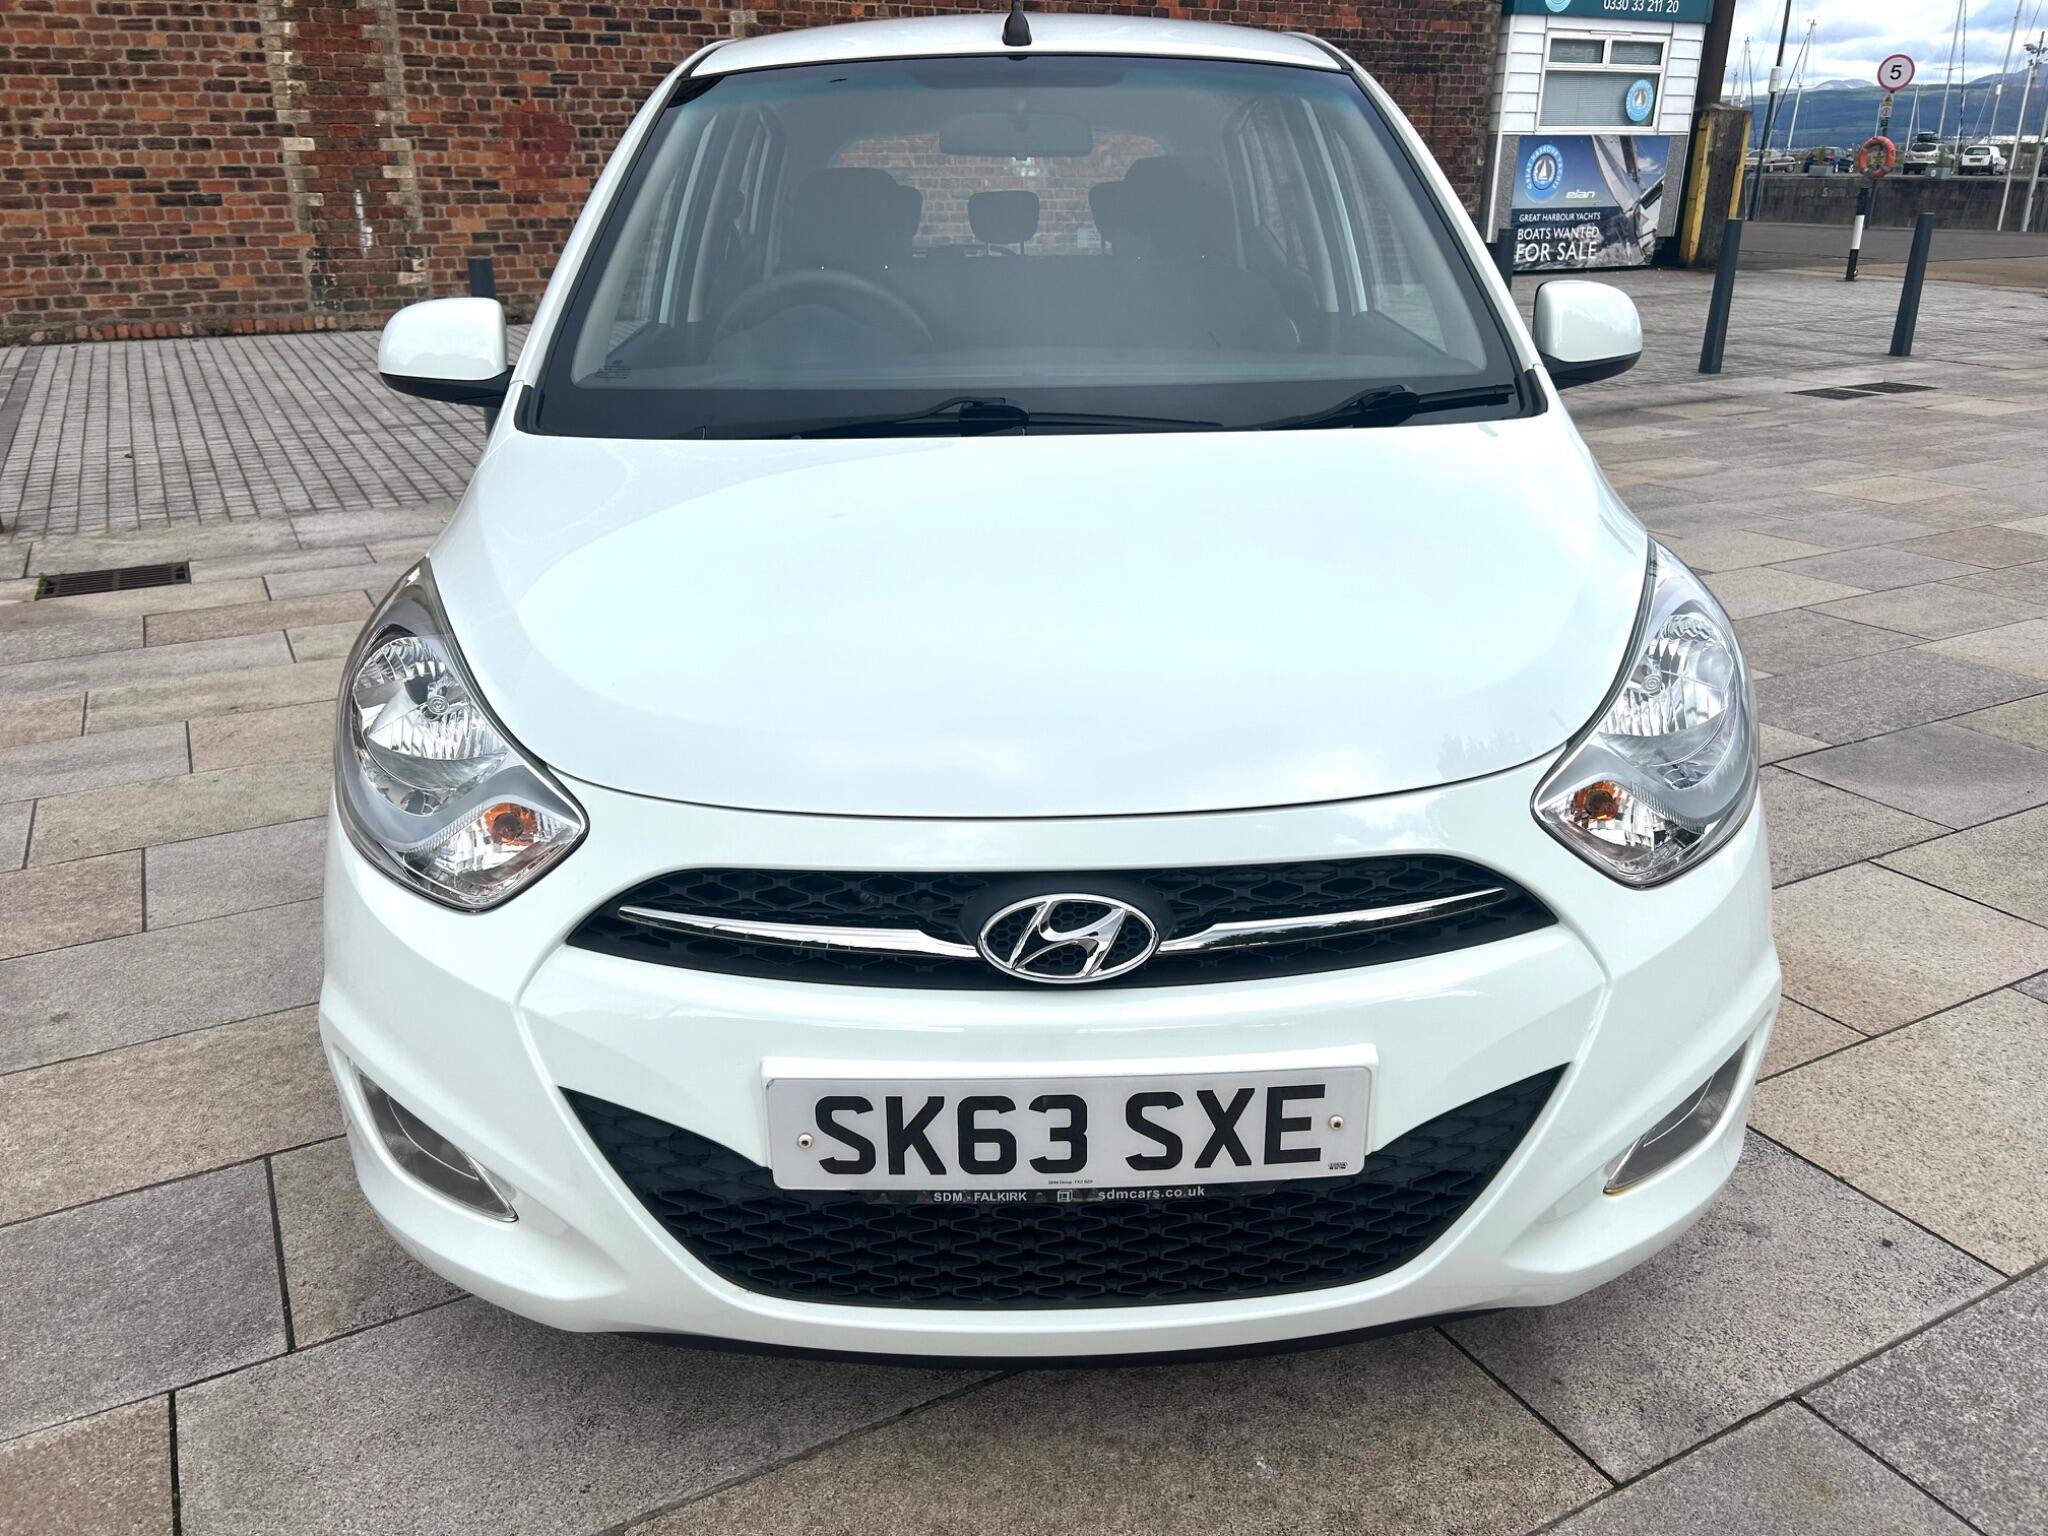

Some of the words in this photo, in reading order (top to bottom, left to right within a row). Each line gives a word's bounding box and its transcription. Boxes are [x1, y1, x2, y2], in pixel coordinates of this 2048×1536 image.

[1603, 0, 1628, 10] 0330
[1631, 0, 1644, 11] 33
[1647, 0, 1662, 12] 211
[1666, 0, 1679, 13] 20
[1890, 64, 1903, 80] 5
[1566, 189, 1595, 198] elan
[1519, 214, 1540, 222] GREAT
[1542, 213, 1575, 221] HARBOUR
[1576, 212, 1600, 220] YACHTS
[1517, 227, 1551, 240] BOATS
[1553, 226, 1599, 239] WANTED
[1515, 243, 1550, 262] FOR
[1557, 241, 1597, 260] SALE
[815, 1094, 1088, 1176] SK63
[1125, 1084, 1326, 1171] SXE
[934, 1192, 962, 1201] SDM
[974, 1191, 1027, 1200] FALKIRK
[1098, 1185, 1205, 1200] sdmcars.co.uk
